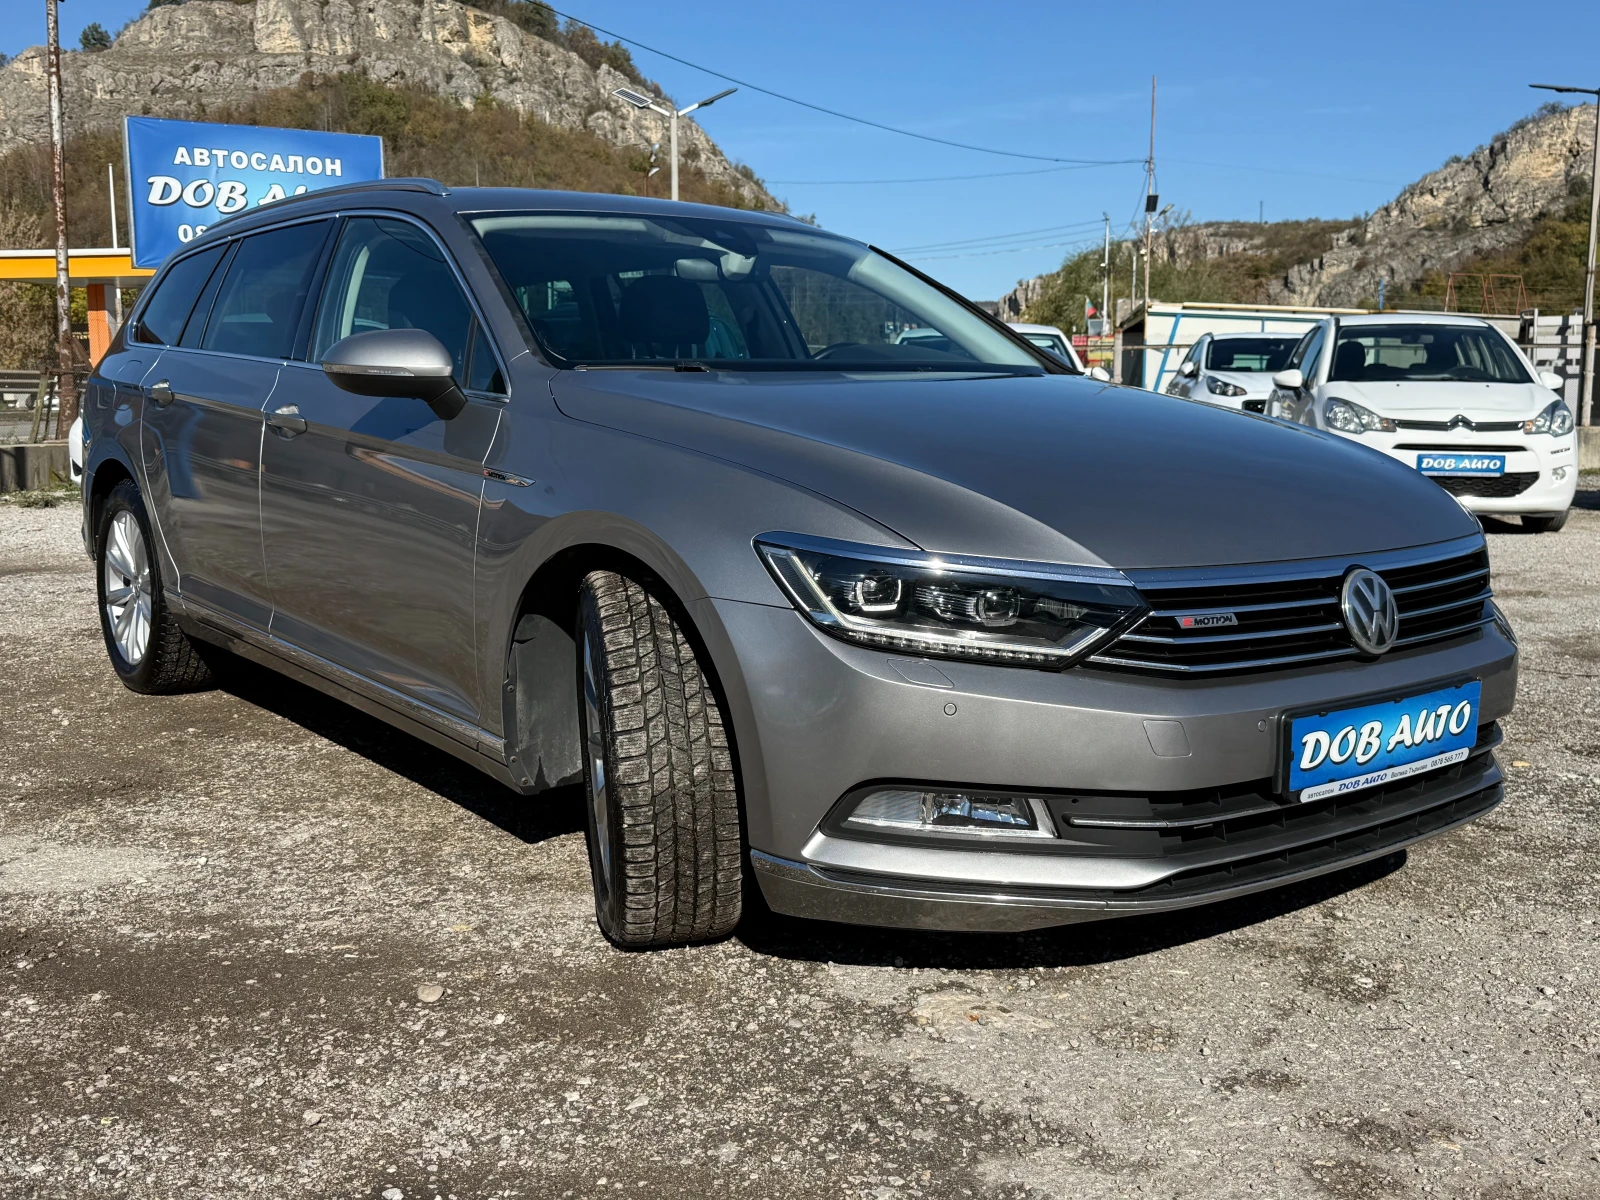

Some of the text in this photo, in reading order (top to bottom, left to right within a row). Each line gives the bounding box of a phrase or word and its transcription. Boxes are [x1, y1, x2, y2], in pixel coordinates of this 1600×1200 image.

[173, 146, 342, 177] АВТОСАЛОН
[147, 175, 248, 214] DOB
[1421, 458, 1501, 470] DOB AUTO
[1300, 699, 1472, 771] DOB AUTO
[1338, 779, 1361, 792] DOB
[1361, 772, 1388, 787] AUTO
